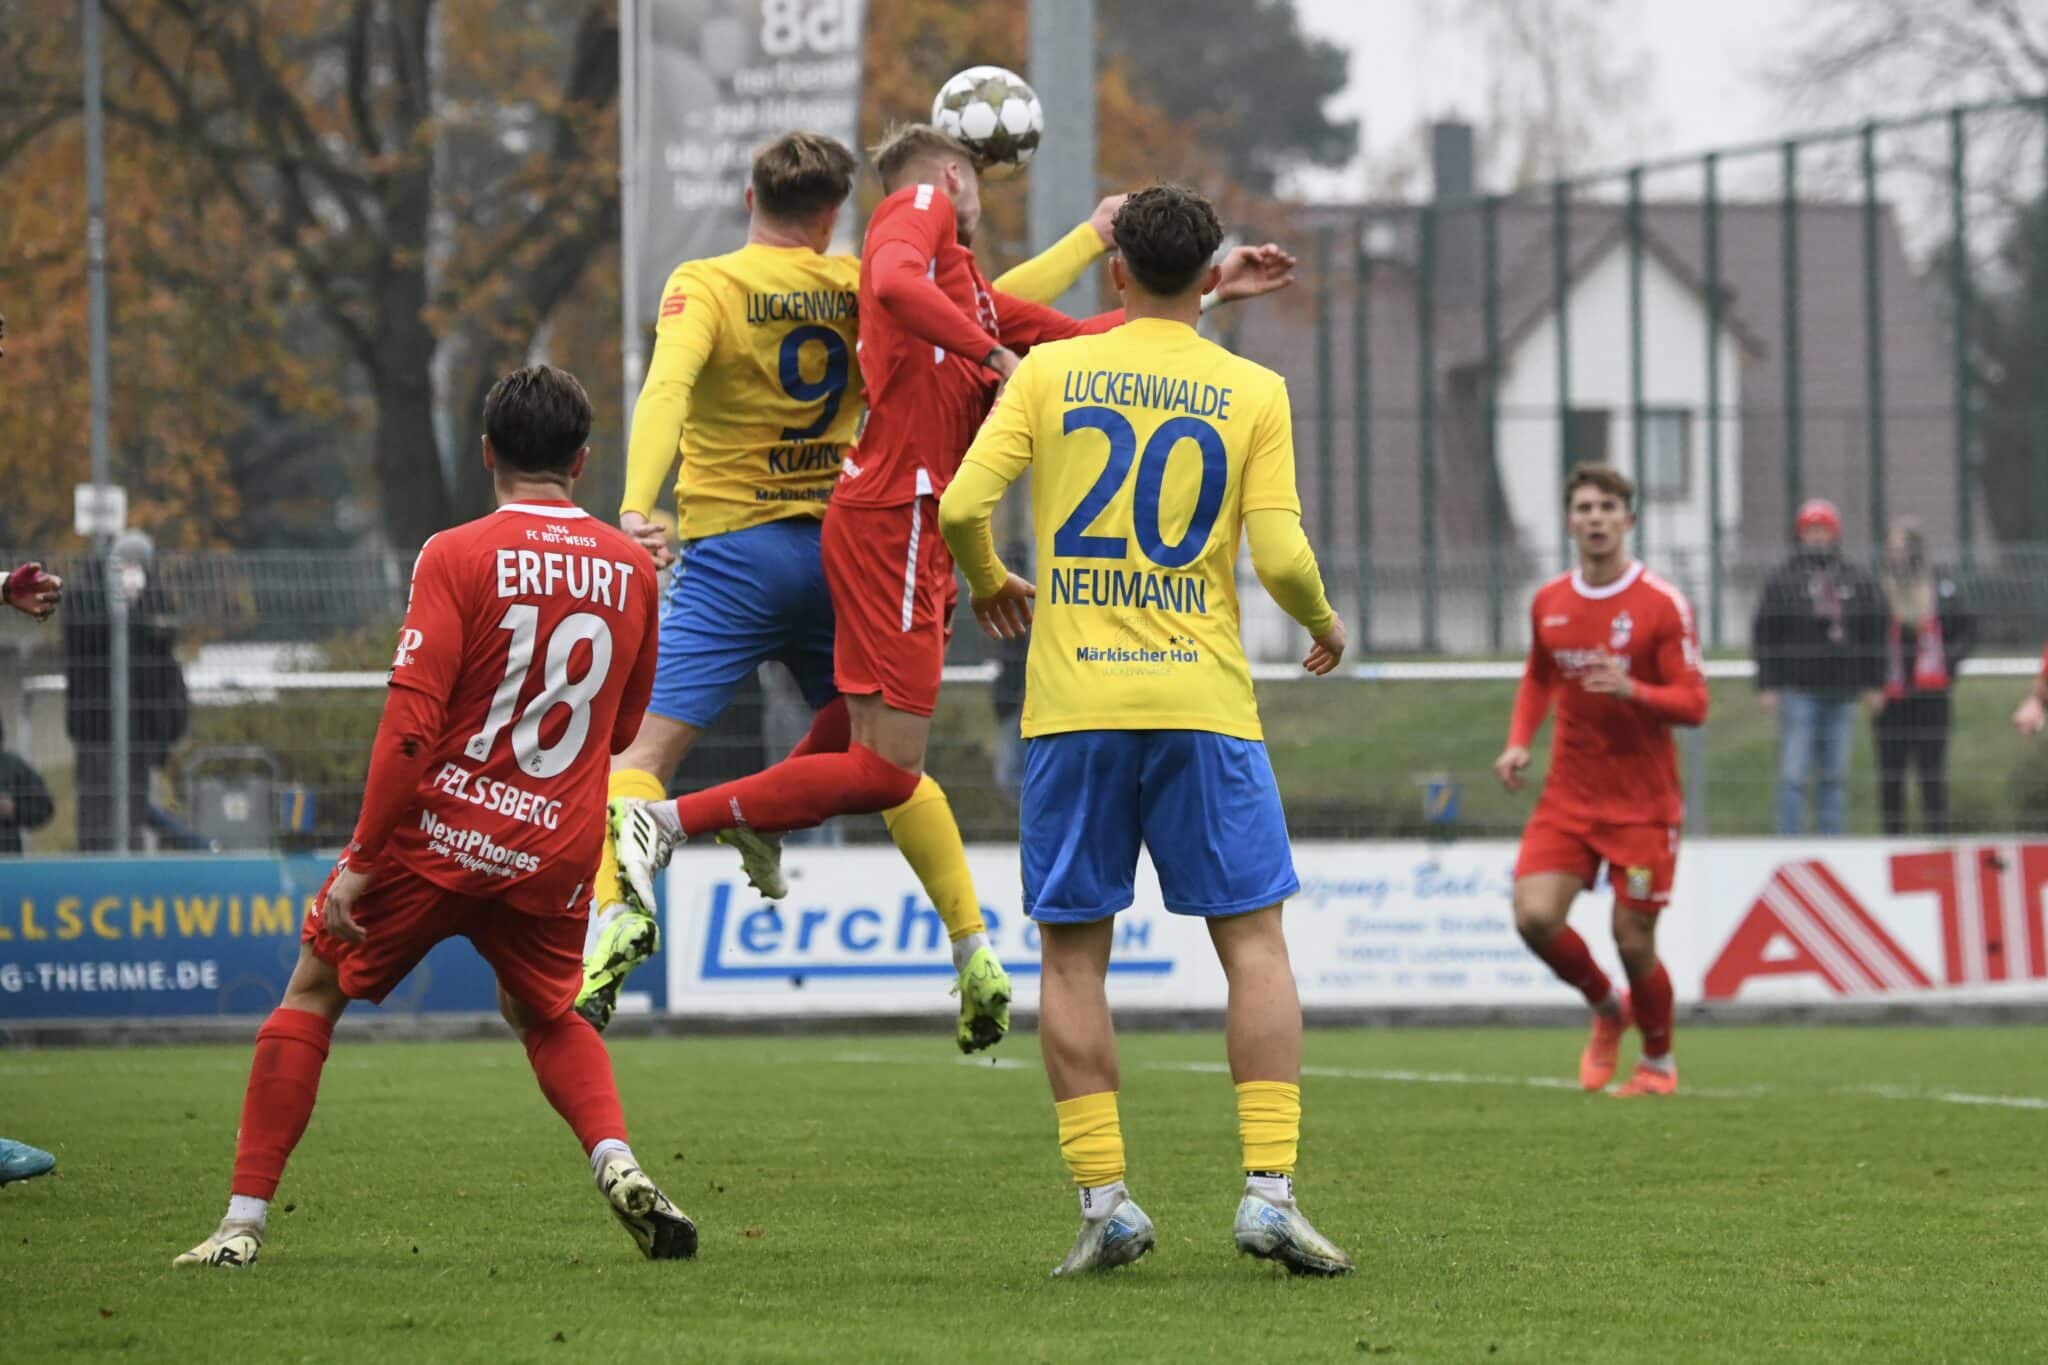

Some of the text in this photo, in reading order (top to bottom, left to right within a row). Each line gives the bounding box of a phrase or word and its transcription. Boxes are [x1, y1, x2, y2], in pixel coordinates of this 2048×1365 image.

[779, 325, 848, 440] 9
[1063, 370, 1233, 420] LUCKENWALDE
[1053, 405, 1227, 568] 20
[525, 529, 598, 548] FC ROT-WEISS
[496, 549, 634, 613] ERFURT
[1051, 567, 1207, 614] NEUMANN
[1076, 646, 1167, 663] Märkischer
[463, 603, 613, 779] 18
[433, 761, 562, 831] FELSSBERG
[419, 809, 541, 873] NextPhones
[0, 960, 219, 993] G-THERME.DE
